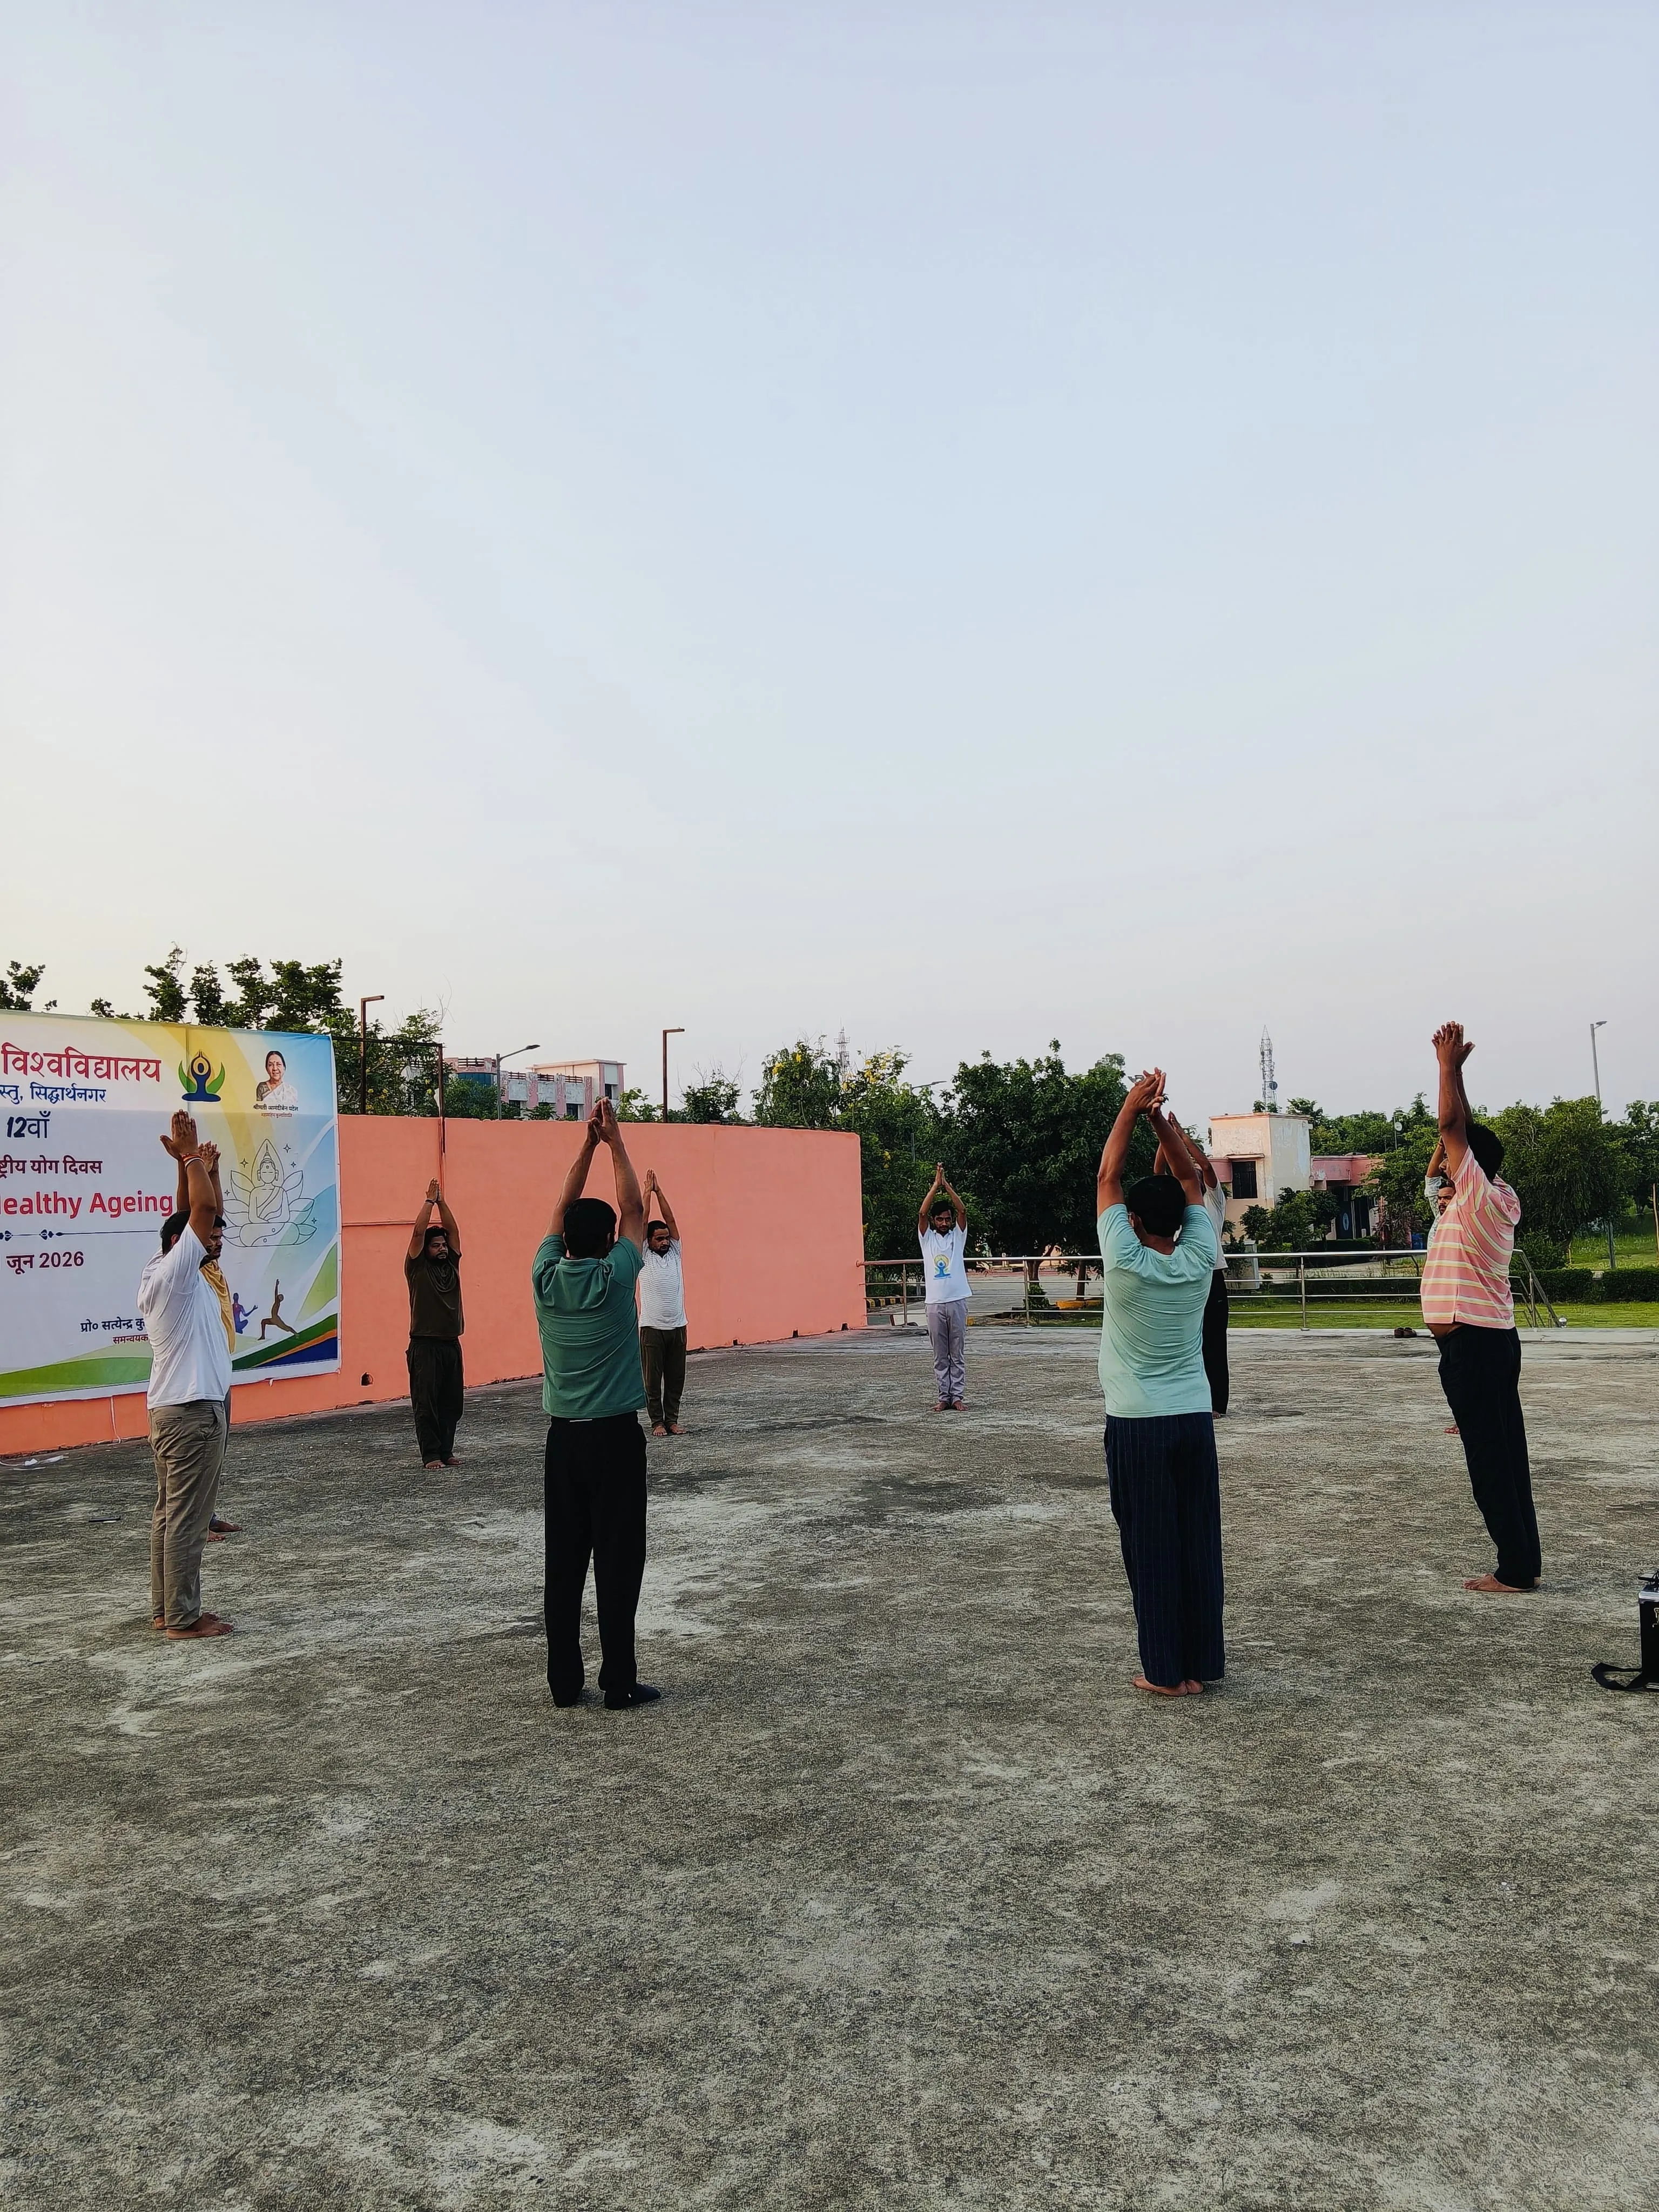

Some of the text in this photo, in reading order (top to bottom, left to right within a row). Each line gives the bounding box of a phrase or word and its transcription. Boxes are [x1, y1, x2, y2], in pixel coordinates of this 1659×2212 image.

[1, 1042, 161, 1083] विश्वविद्यालय
[30, 1082, 106, 1104] सिद्धार्थनगर
[6, 1110, 51, 1139] 12वाँ
[30, 1155, 59, 1174] योग
[63, 1155, 103, 1175] दिवस
[0, 1190, 173, 1219] ealthy Ageing
[6, 1251, 84, 1275] जून 2026
[102, 1317, 133, 1330] सत्येन्द्र
[112, 1334, 149, 1344] समन्वयक
